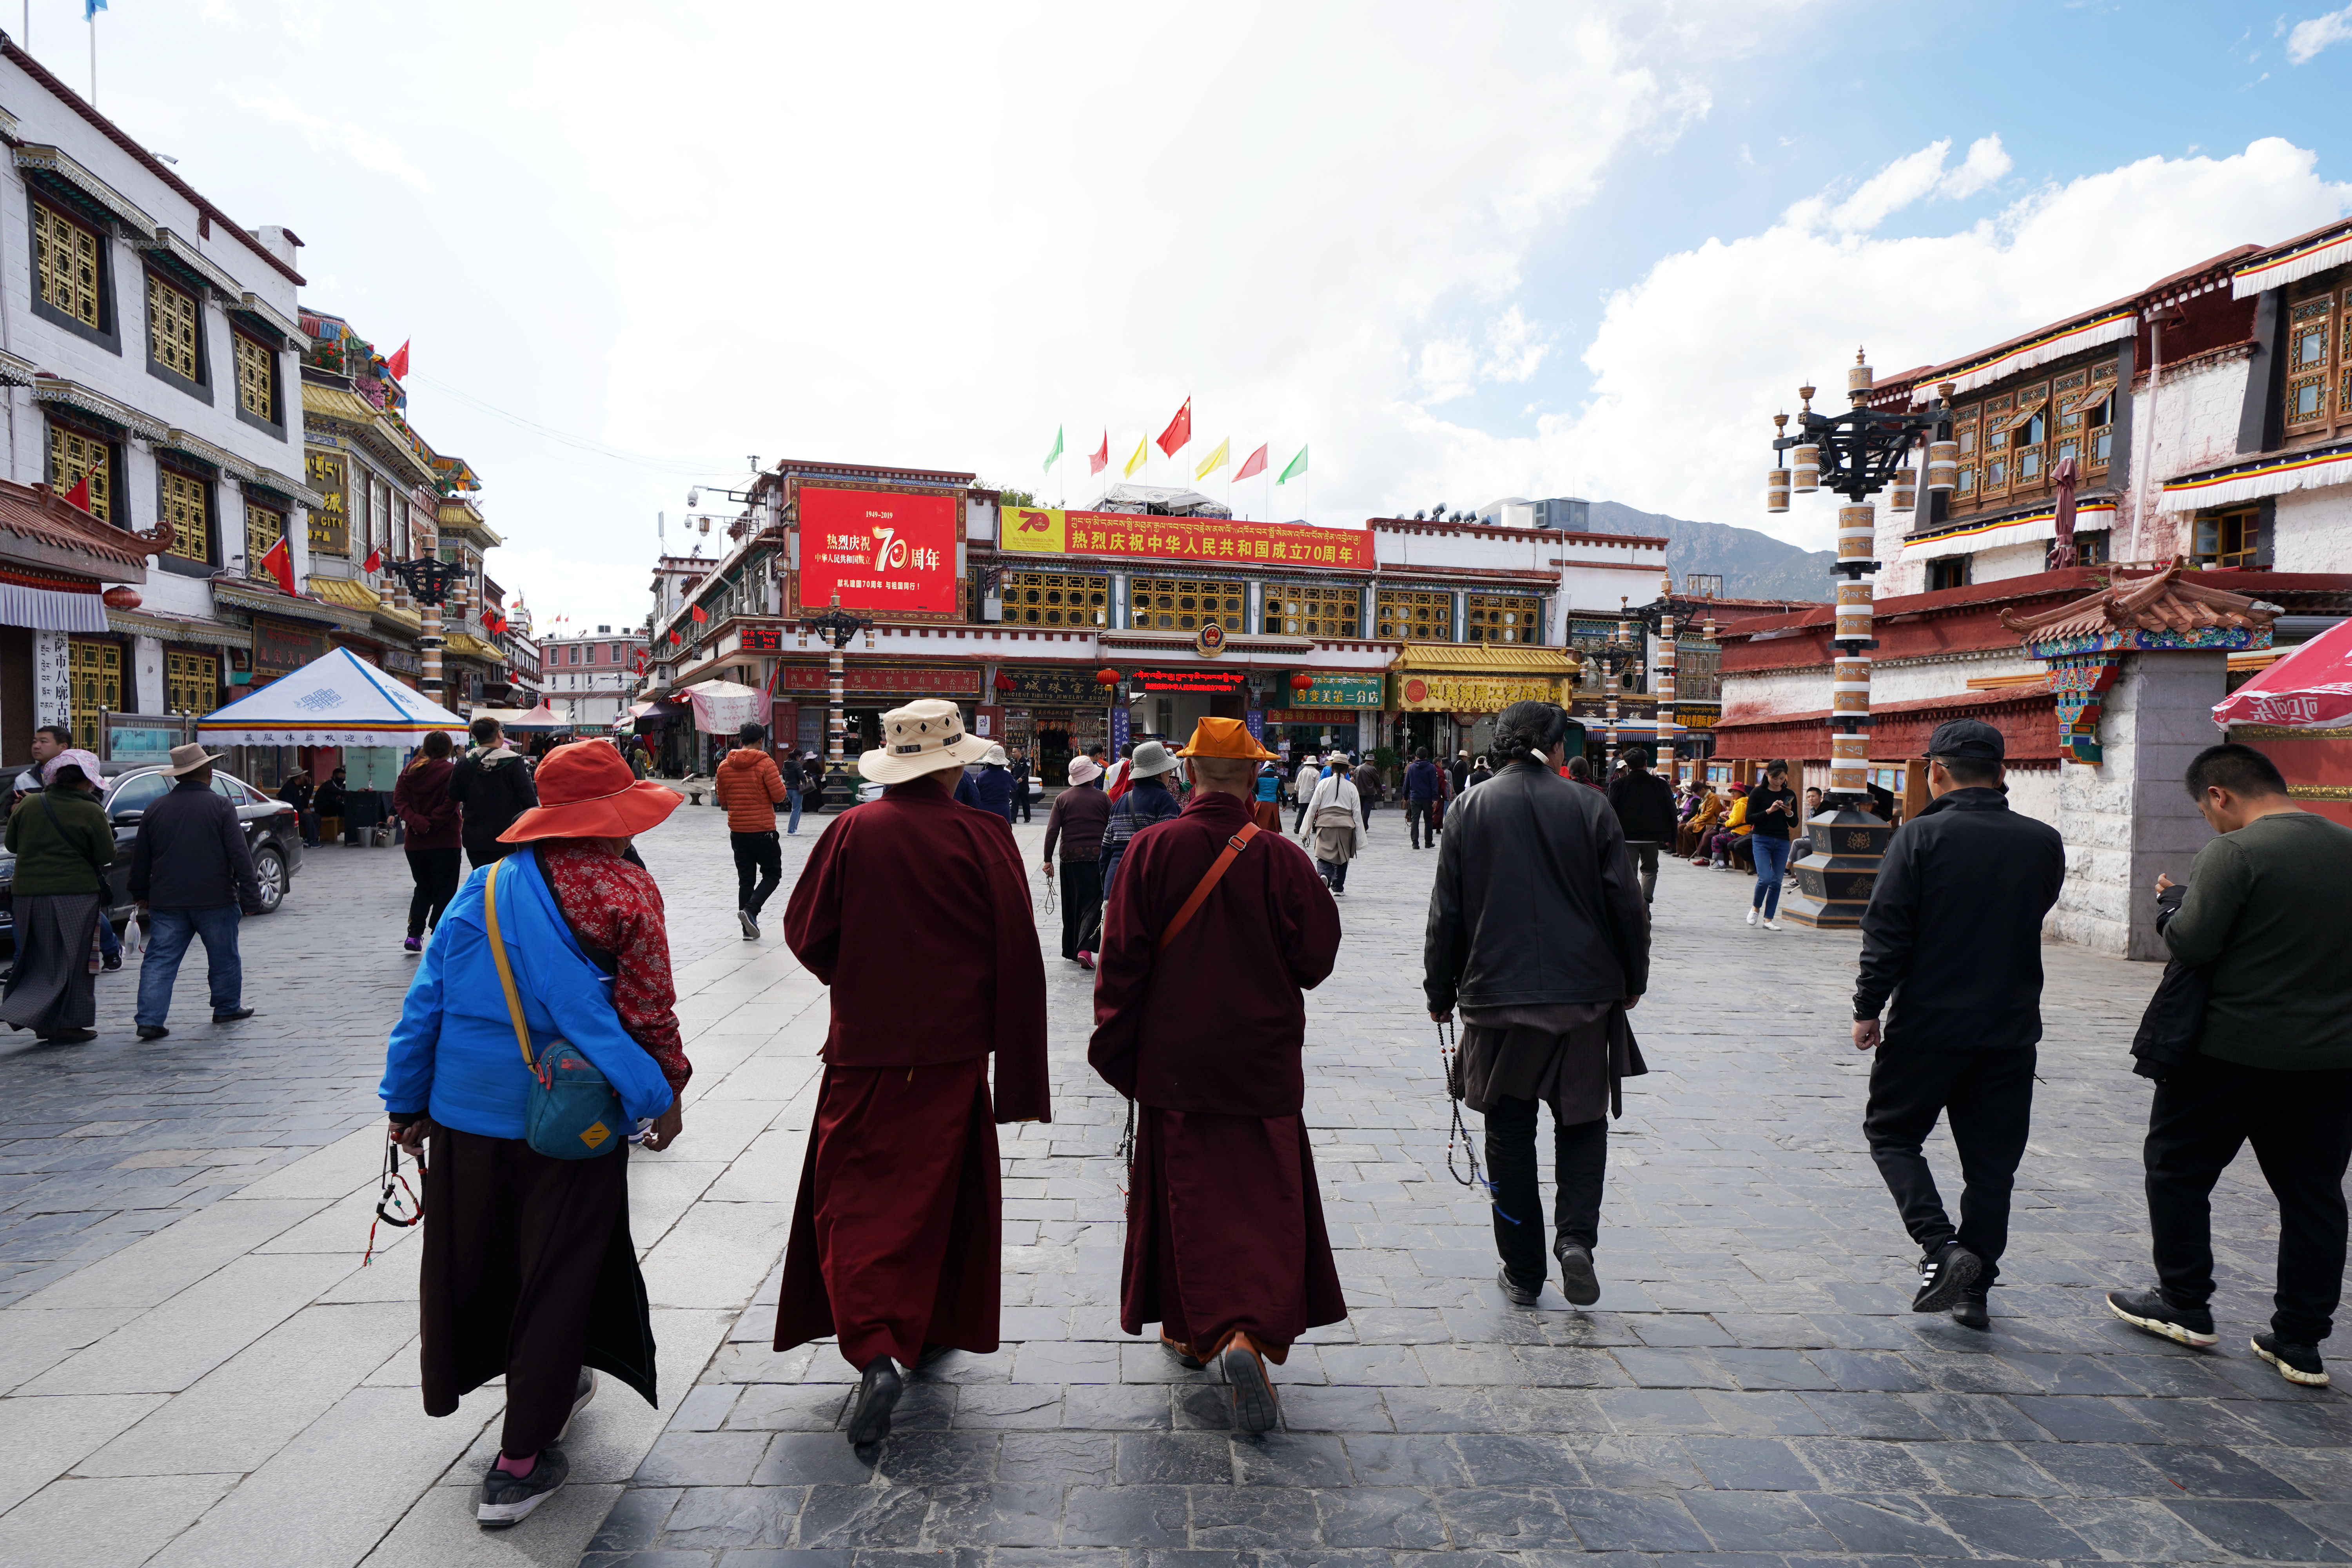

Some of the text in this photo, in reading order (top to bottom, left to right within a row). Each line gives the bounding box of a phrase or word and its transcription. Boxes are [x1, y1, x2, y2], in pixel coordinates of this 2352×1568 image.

[321, 516, 343, 528] CITY
[827, 534, 871, 551] 热烈庆祝
[815, 553, 871, 565] 中华人民共和国成立
[837, 579, 882, 589] 献礼建国70周年
[1274, 711, 1350, 722] 全场特价100元
